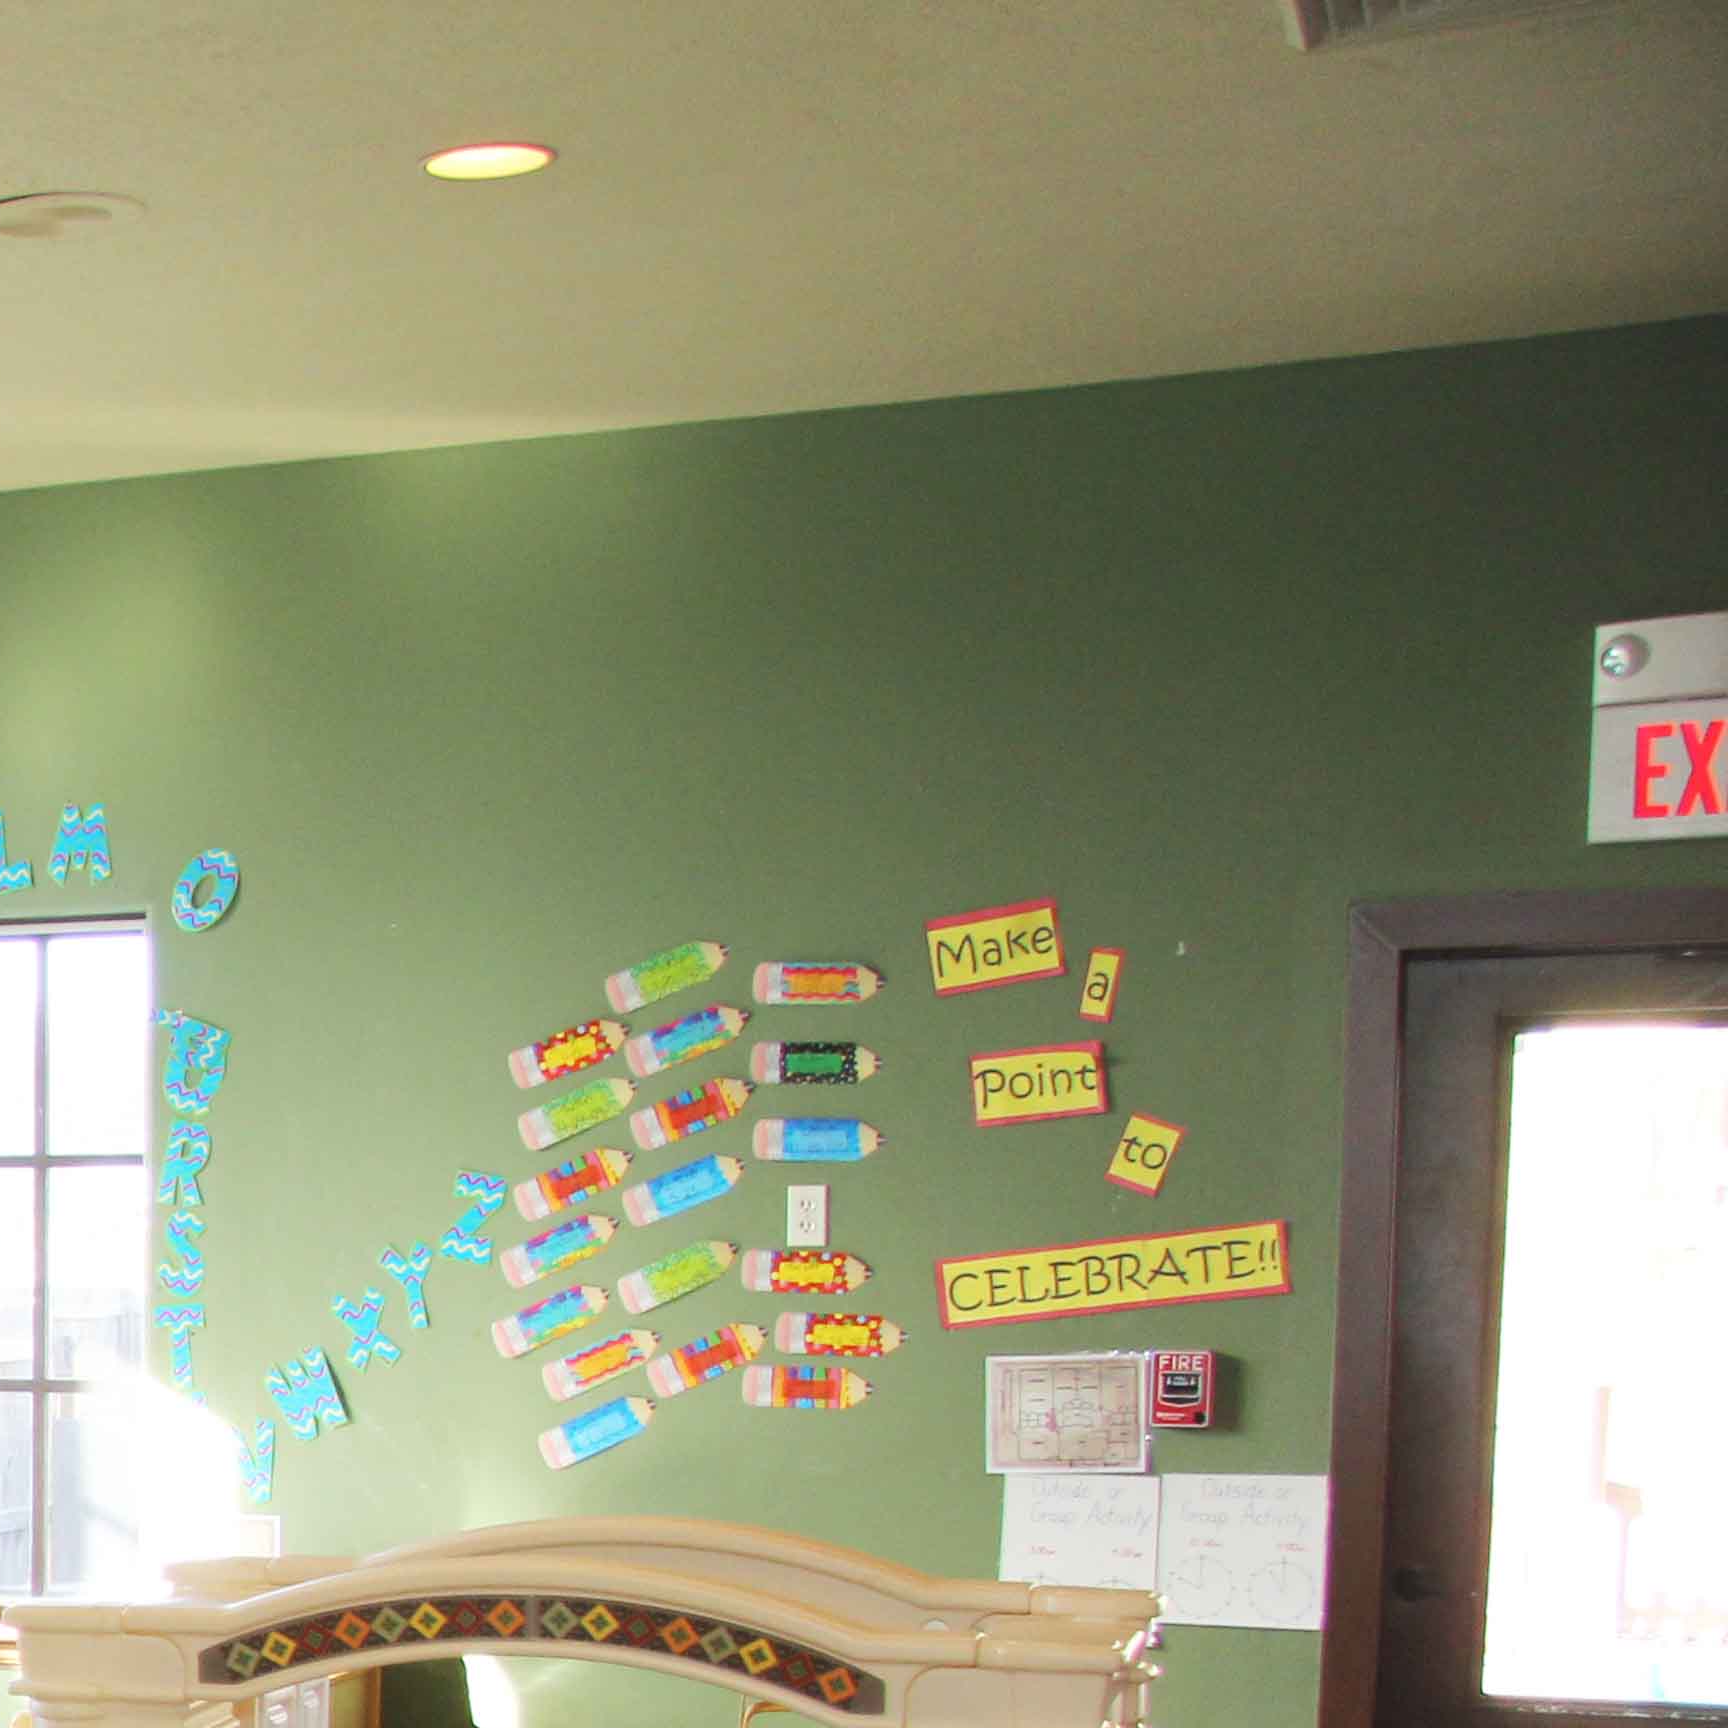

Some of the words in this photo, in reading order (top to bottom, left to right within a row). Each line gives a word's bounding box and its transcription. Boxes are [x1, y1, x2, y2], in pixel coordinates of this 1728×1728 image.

[1632, 718, 1728, 819] EX
[47, 801, 113, 887] M
[171, 847, 240, 931] O
[934, 925, 1055, 979] Make
[1087, 971, 1109, 1001] a
[158, 1119, 212, 1206] R
[1122, 1133, 1167, 1170] to
[157, 1209, 206, 1297] S
[440, 1169, 508, 1264] Z
[378, 1240, 433, 1328] Y
[948, 1238, 1279, 1312] CELEBRATE!!
[154, 1302, 206, 1389] T
[330, 1285, 402, 1371] X
[1159, 1355, 1204, 1371] FIRE
[264, 1344, 350, 1440] W
